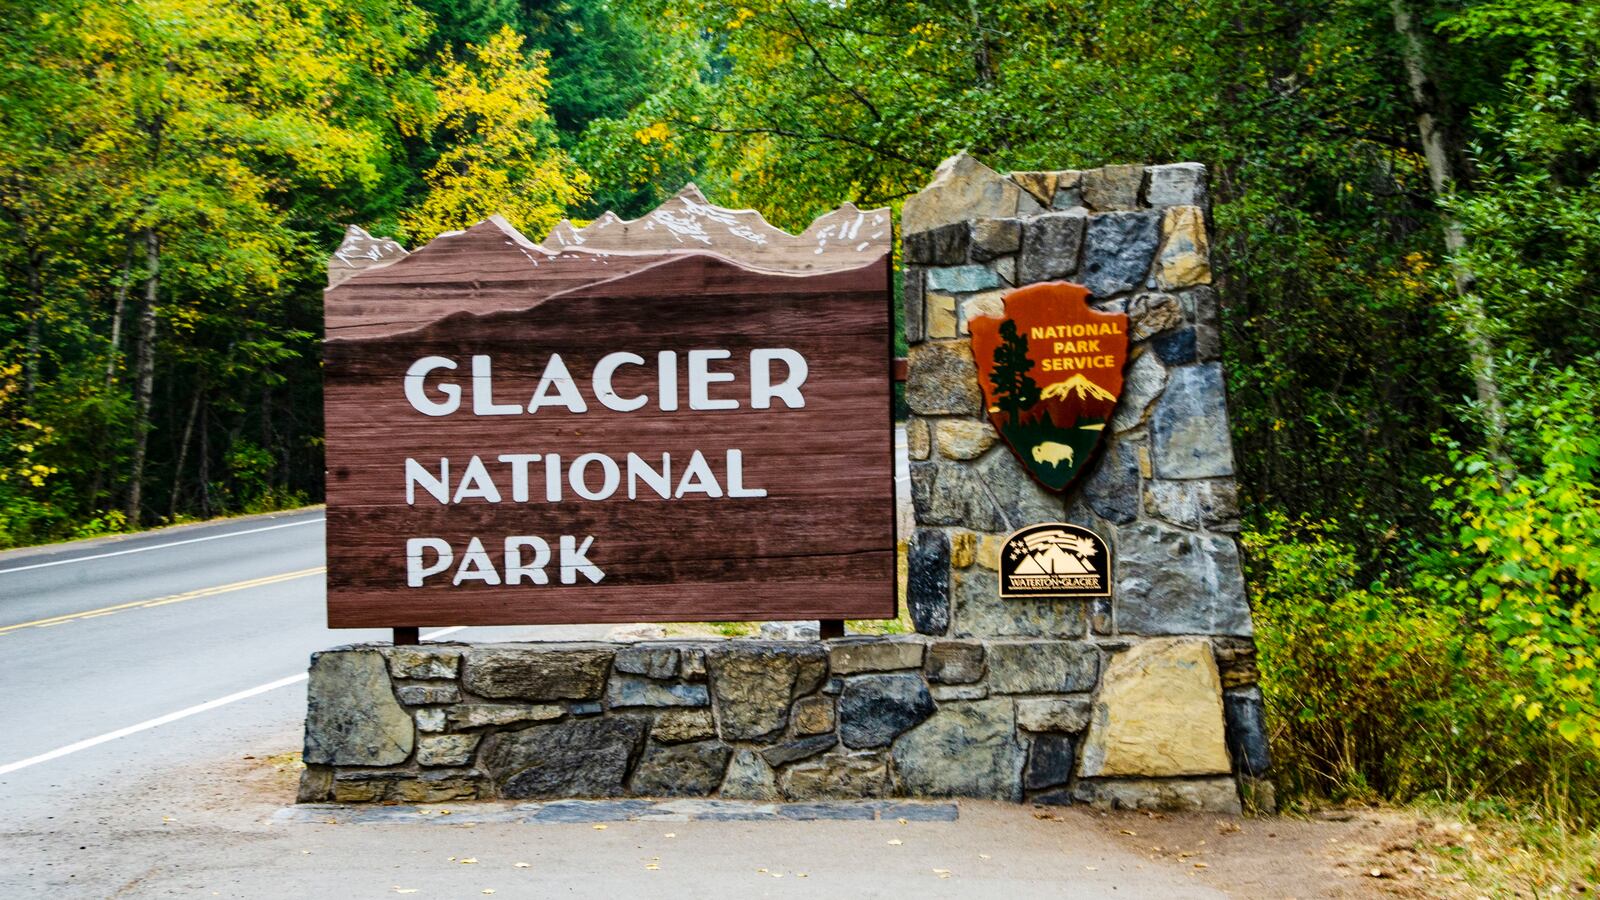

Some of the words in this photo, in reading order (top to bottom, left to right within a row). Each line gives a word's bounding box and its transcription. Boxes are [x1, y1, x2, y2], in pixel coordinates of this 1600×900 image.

[1031, 322, 1122, 339] NATIONAL
[1053, 340, 1100, 354] PARK
[1041, 355, 1115, 372] SERVICE
[403, 348, 809, 417] GLACIER
[404, 449, 768, 505] NATIONAL
[406, 535, 606, 588] PARK
